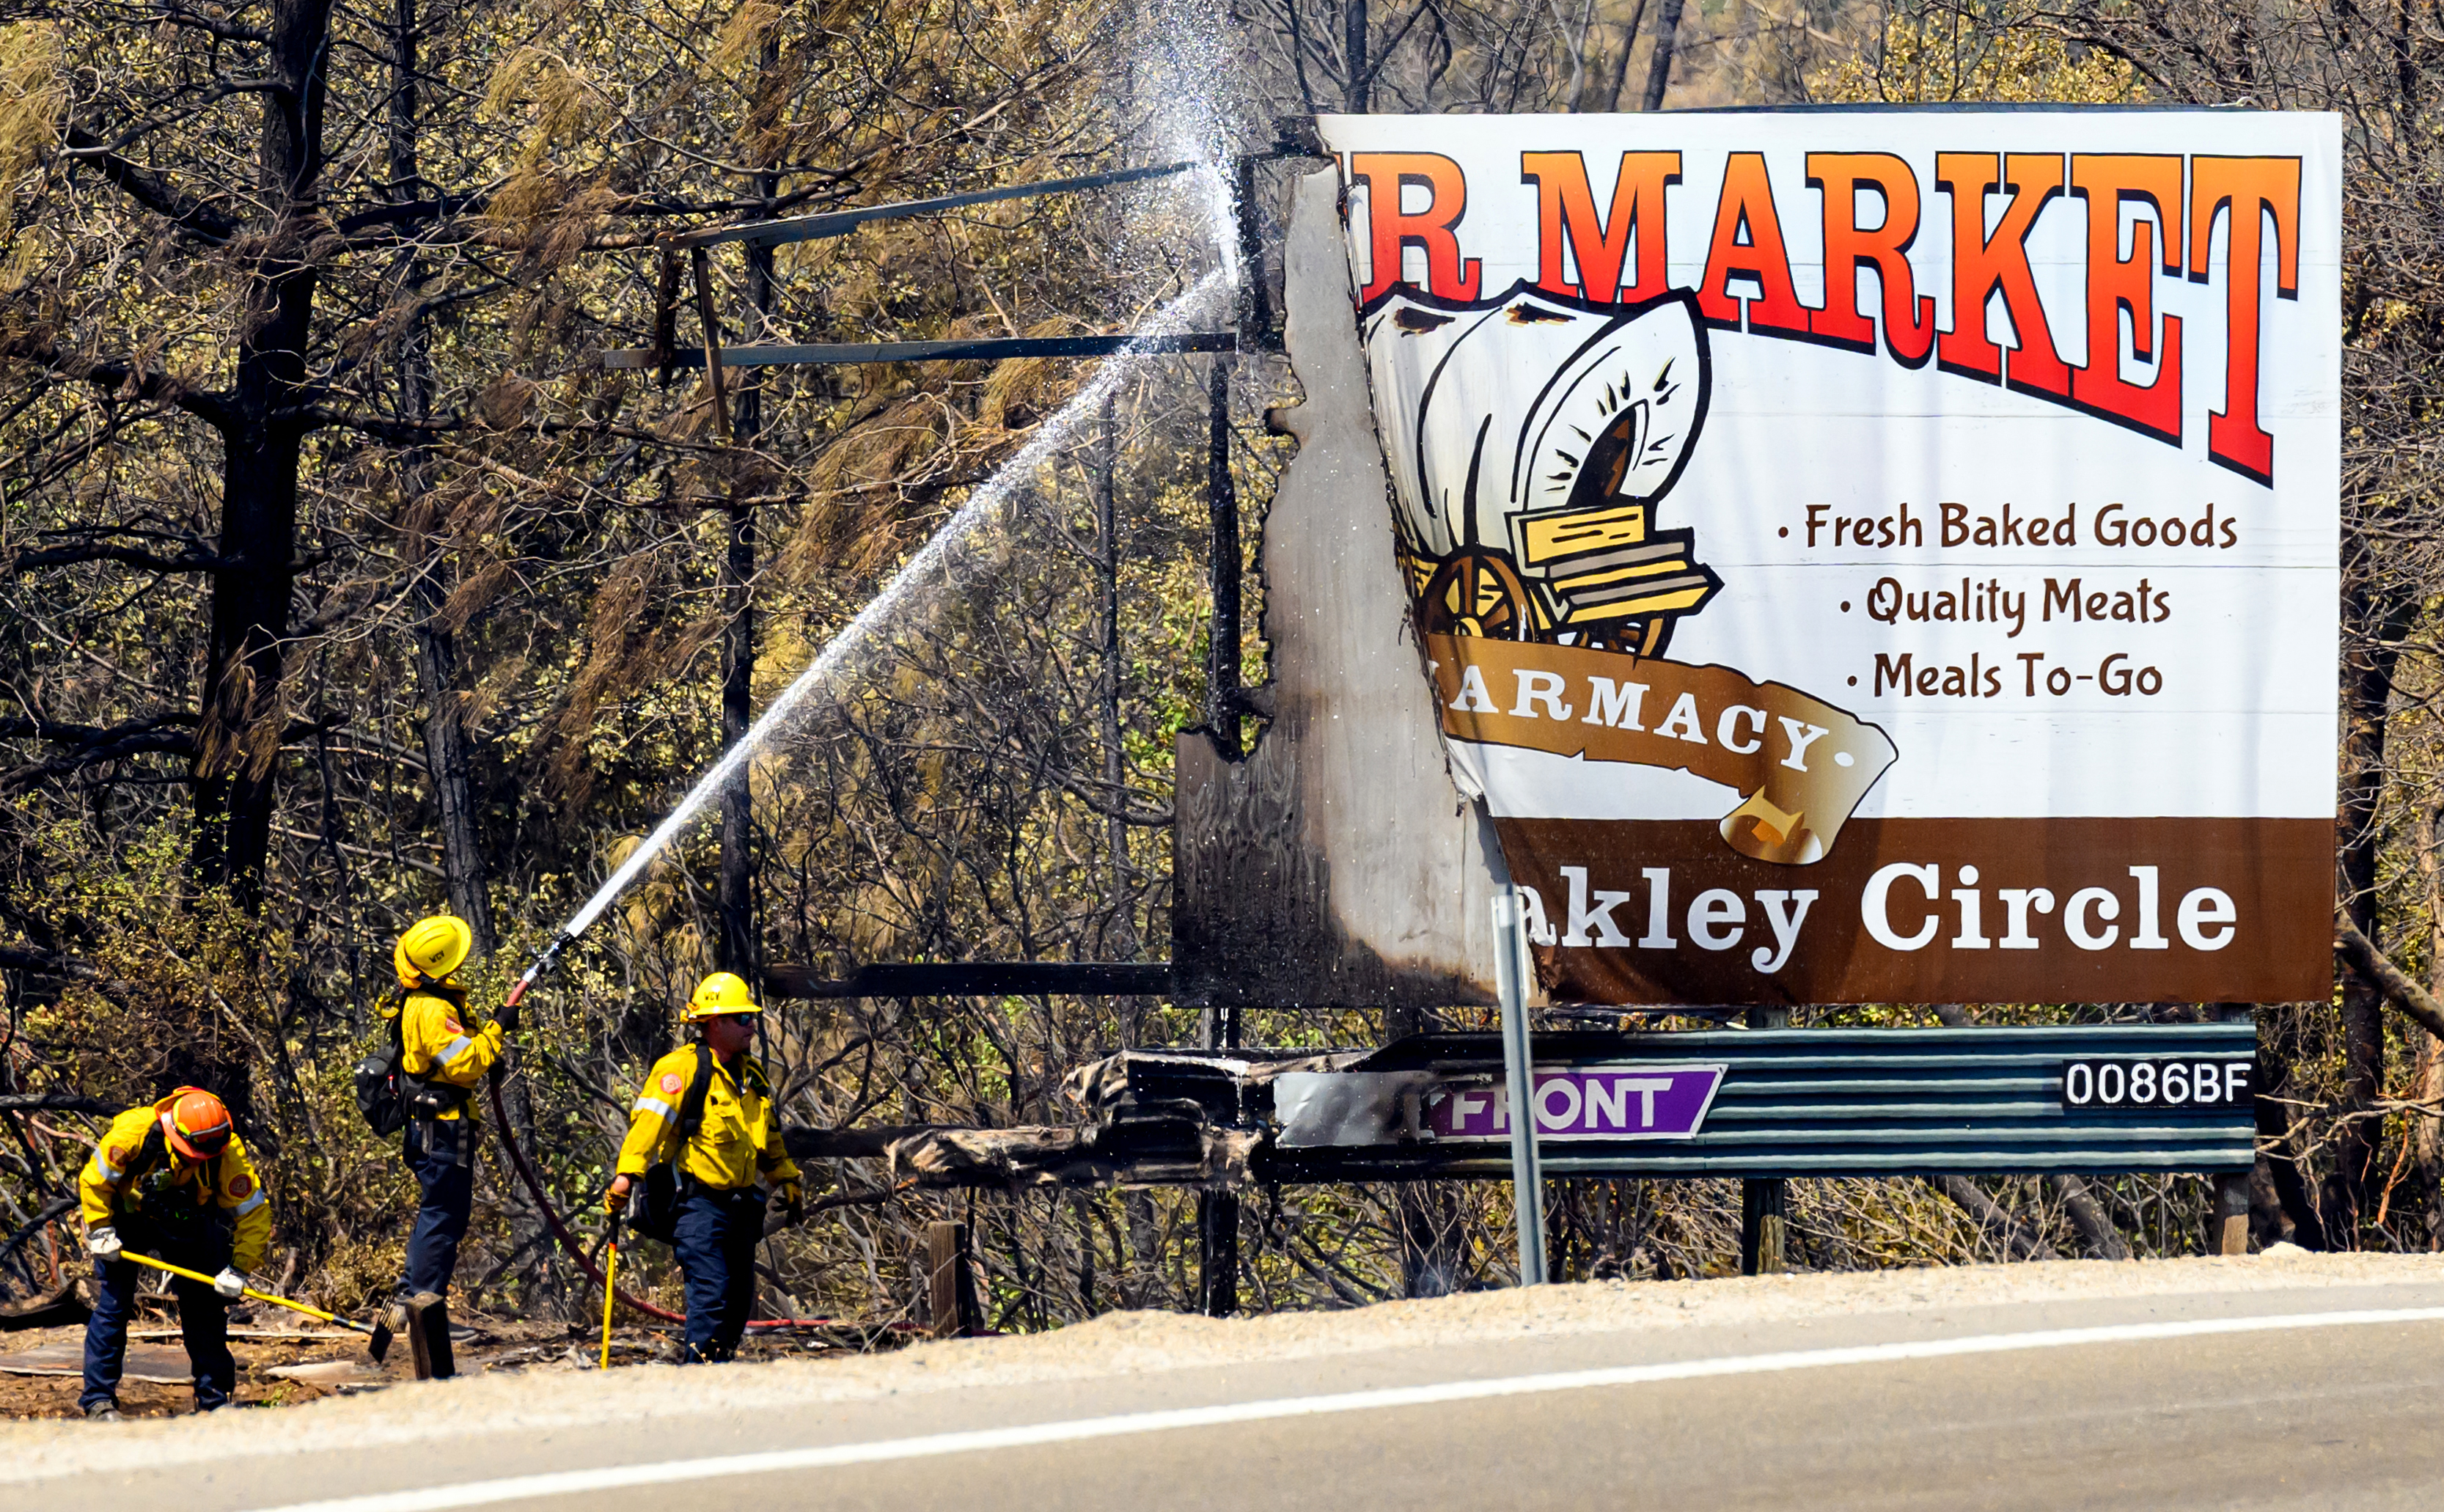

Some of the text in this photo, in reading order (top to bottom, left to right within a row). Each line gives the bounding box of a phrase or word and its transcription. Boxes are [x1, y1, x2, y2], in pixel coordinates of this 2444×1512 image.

[1333, 149, 2303, 490] R MARKET
[1805, 502, 2238, 549] Fresh Baked Goods
[1867, 576, 2171, 639] Quality Meats
[1874, 652, 2163, 699] Meals To-Go
[1428, 660, 1830, 773] ARMACY
[1860, 862, 2237, 952] Circle
[2066, 1063, 2252, 1104] 0086BF
